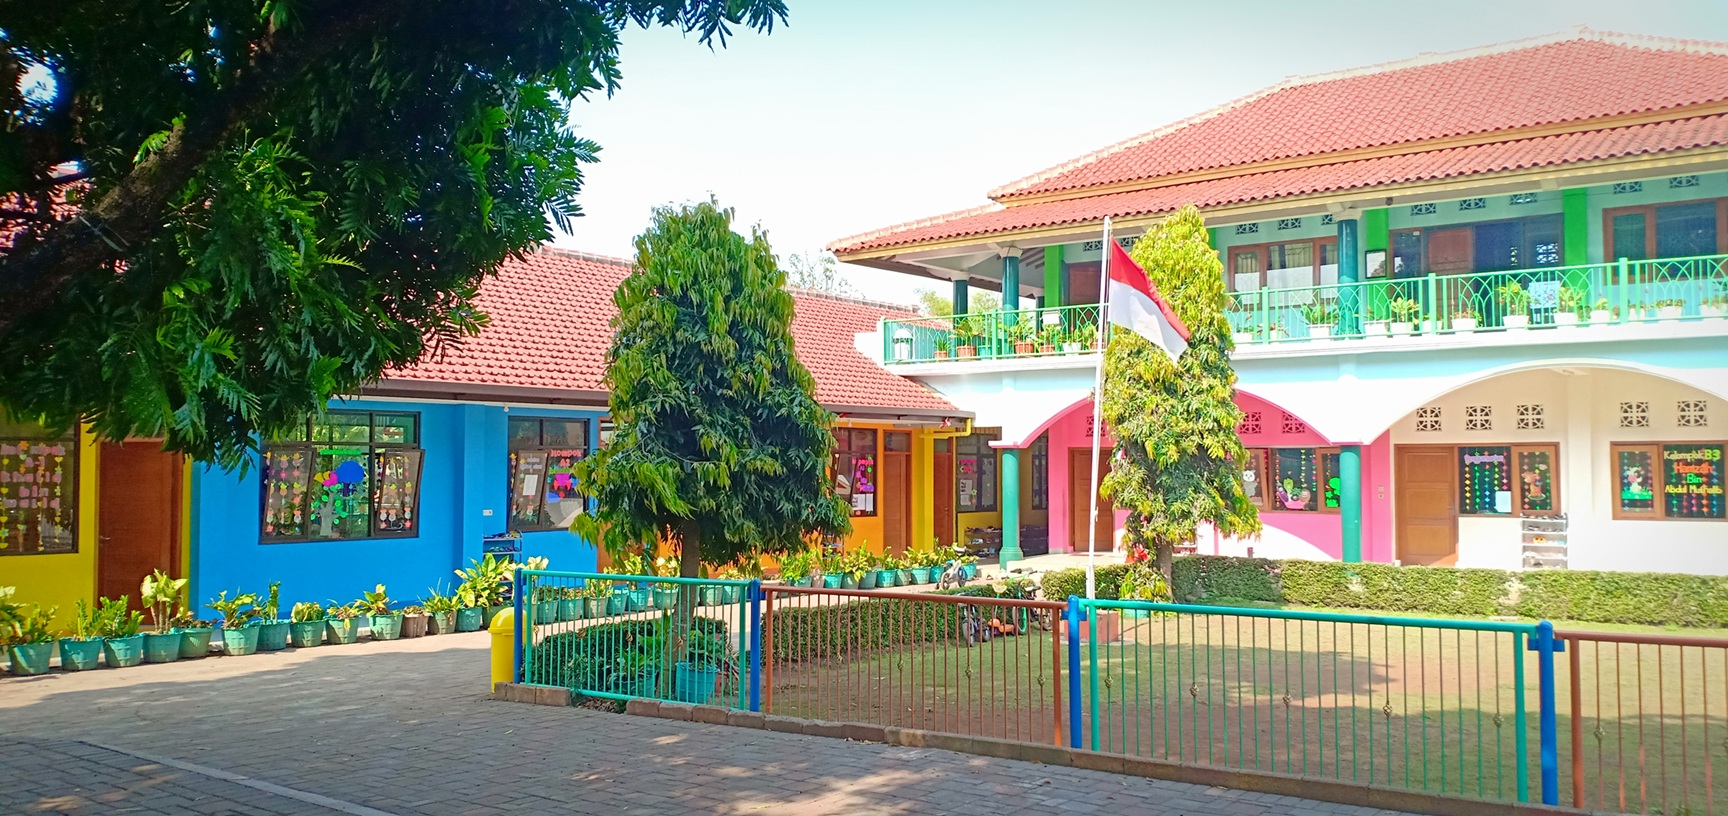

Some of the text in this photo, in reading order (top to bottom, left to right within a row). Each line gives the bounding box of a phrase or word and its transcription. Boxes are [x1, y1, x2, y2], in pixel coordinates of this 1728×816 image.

[1664, 449, 1720, 462] Kelompok B3
[1687, 473, 1702, 483] Bin
[1665, 485, 1687, 493] Abdul
